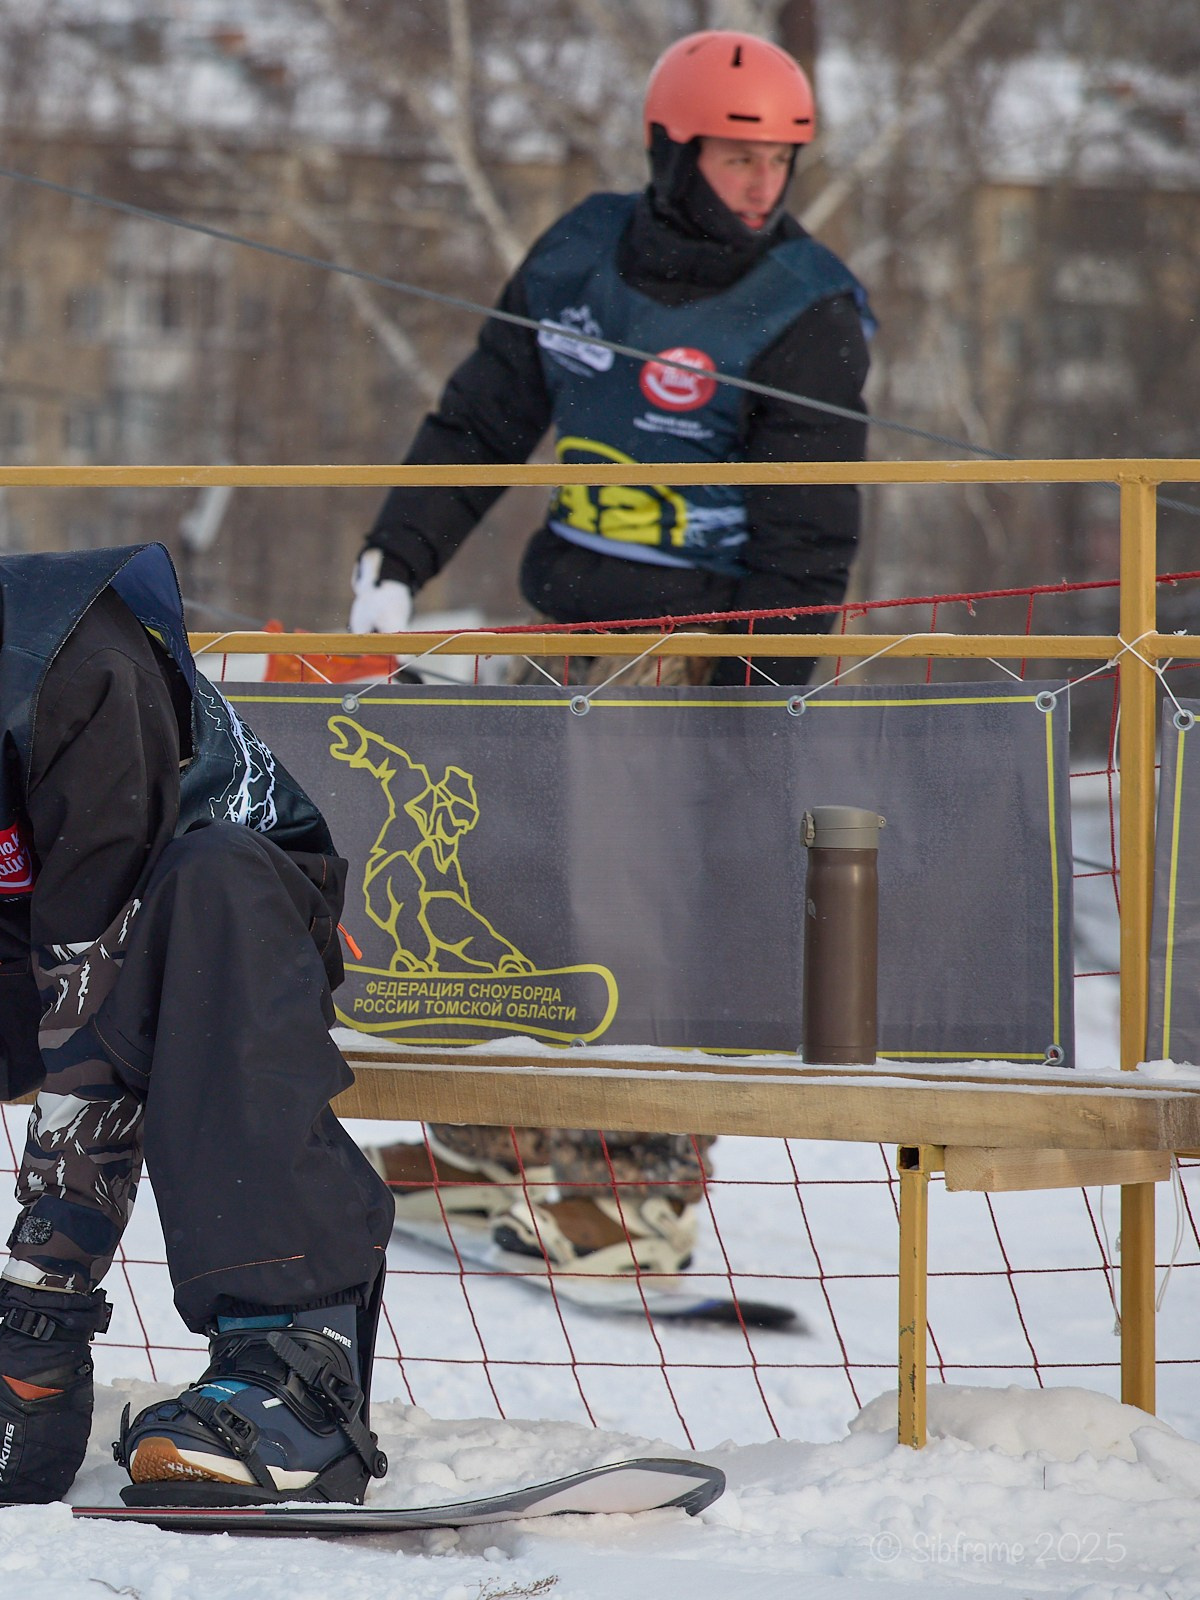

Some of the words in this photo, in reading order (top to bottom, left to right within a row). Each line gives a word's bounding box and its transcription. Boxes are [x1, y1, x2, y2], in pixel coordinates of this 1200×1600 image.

[366, 981, 464, 999] ФЕДЕРАЦИЯ
[468, 983, 562, 1004] СНОУБОРДА
[353, 998, 420, 1014] РОССИИ
[425, 1000, 502, 1018] ТОМСКОЙ
[506, 1003, 577, 1022] ОБЛАСТИ
[322, 1326, 352, 1349] EMPIRE
